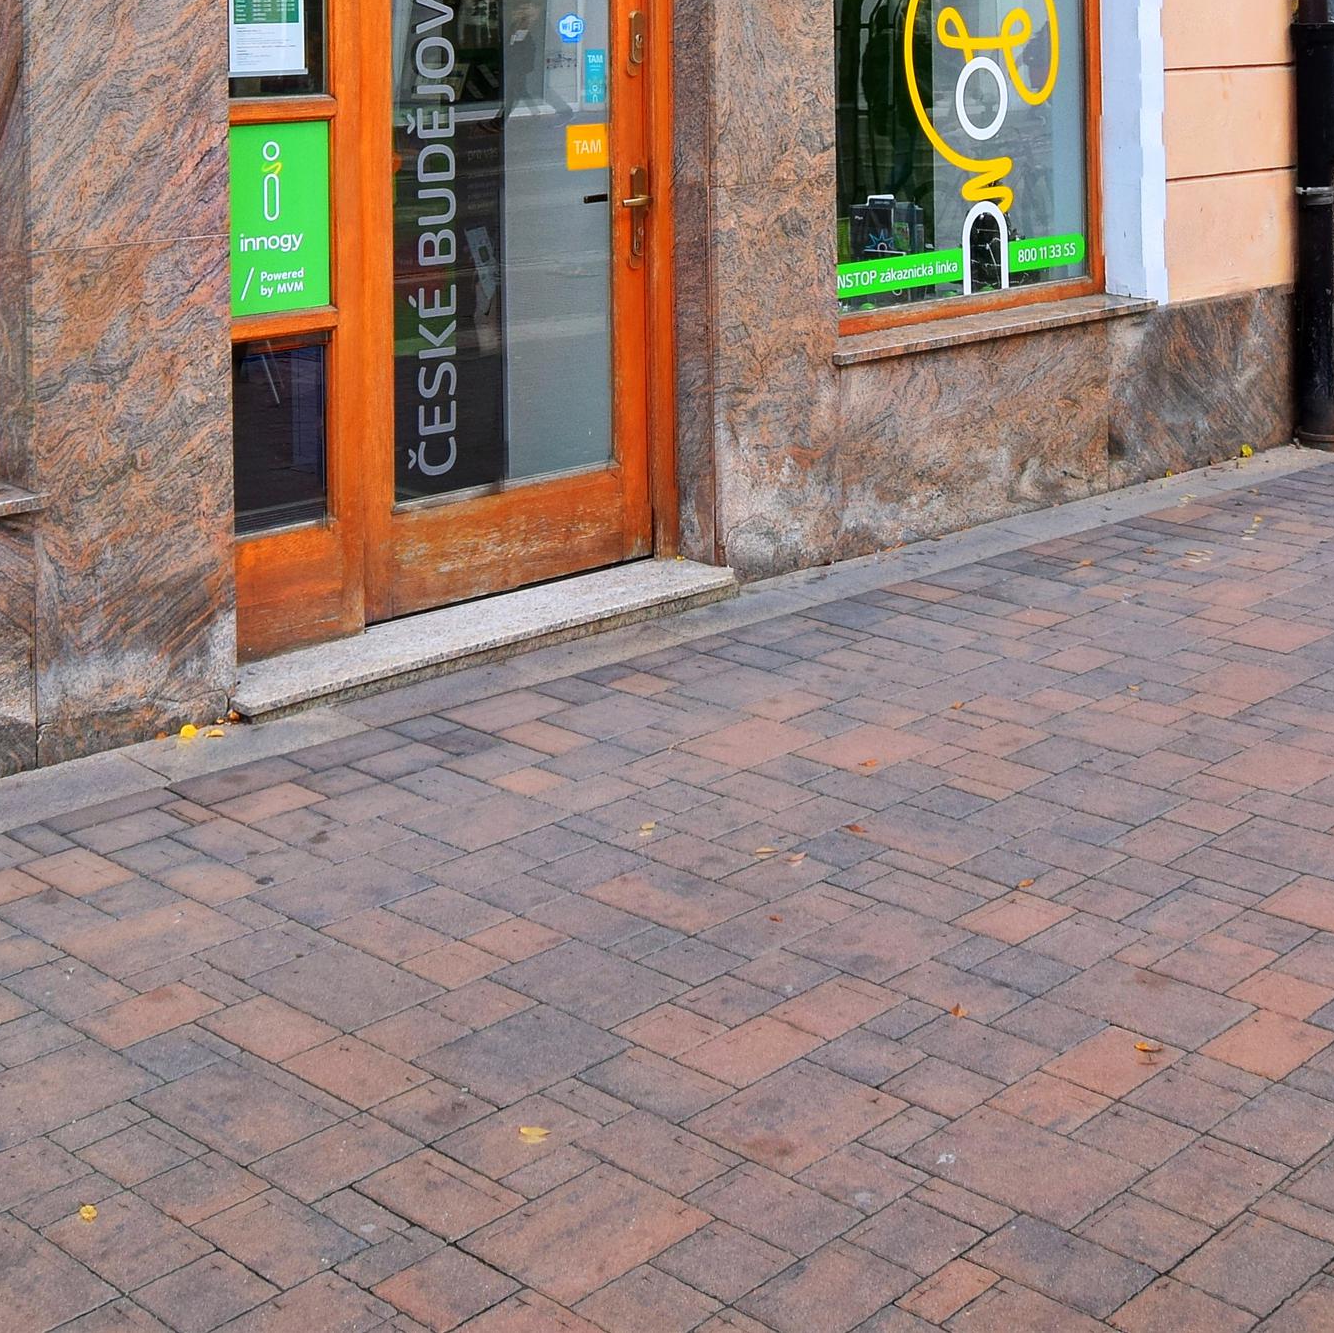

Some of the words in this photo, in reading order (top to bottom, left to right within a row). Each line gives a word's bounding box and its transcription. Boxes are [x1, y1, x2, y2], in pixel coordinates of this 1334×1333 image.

[587, 54, 604, 64] TAM
[574, 139, 602, 156] TAM
[239, 233, 304, 253] innogy
[879, 264, 935, 285] zákaznická
[935, 259, 959, 276] linka
[1018, 246, 1038, 263] 800
[1039, 246, 1049, 260] 11
[1048, 244, 1063, 259] 33
[1063, 242, 1077, 257] 55
[260, 267, 305, 283] Powered
[260, 283, 274, 299] by
[276, 281, 305, 294] MVM
[408, 283, 457, 477] ČESKÉ
